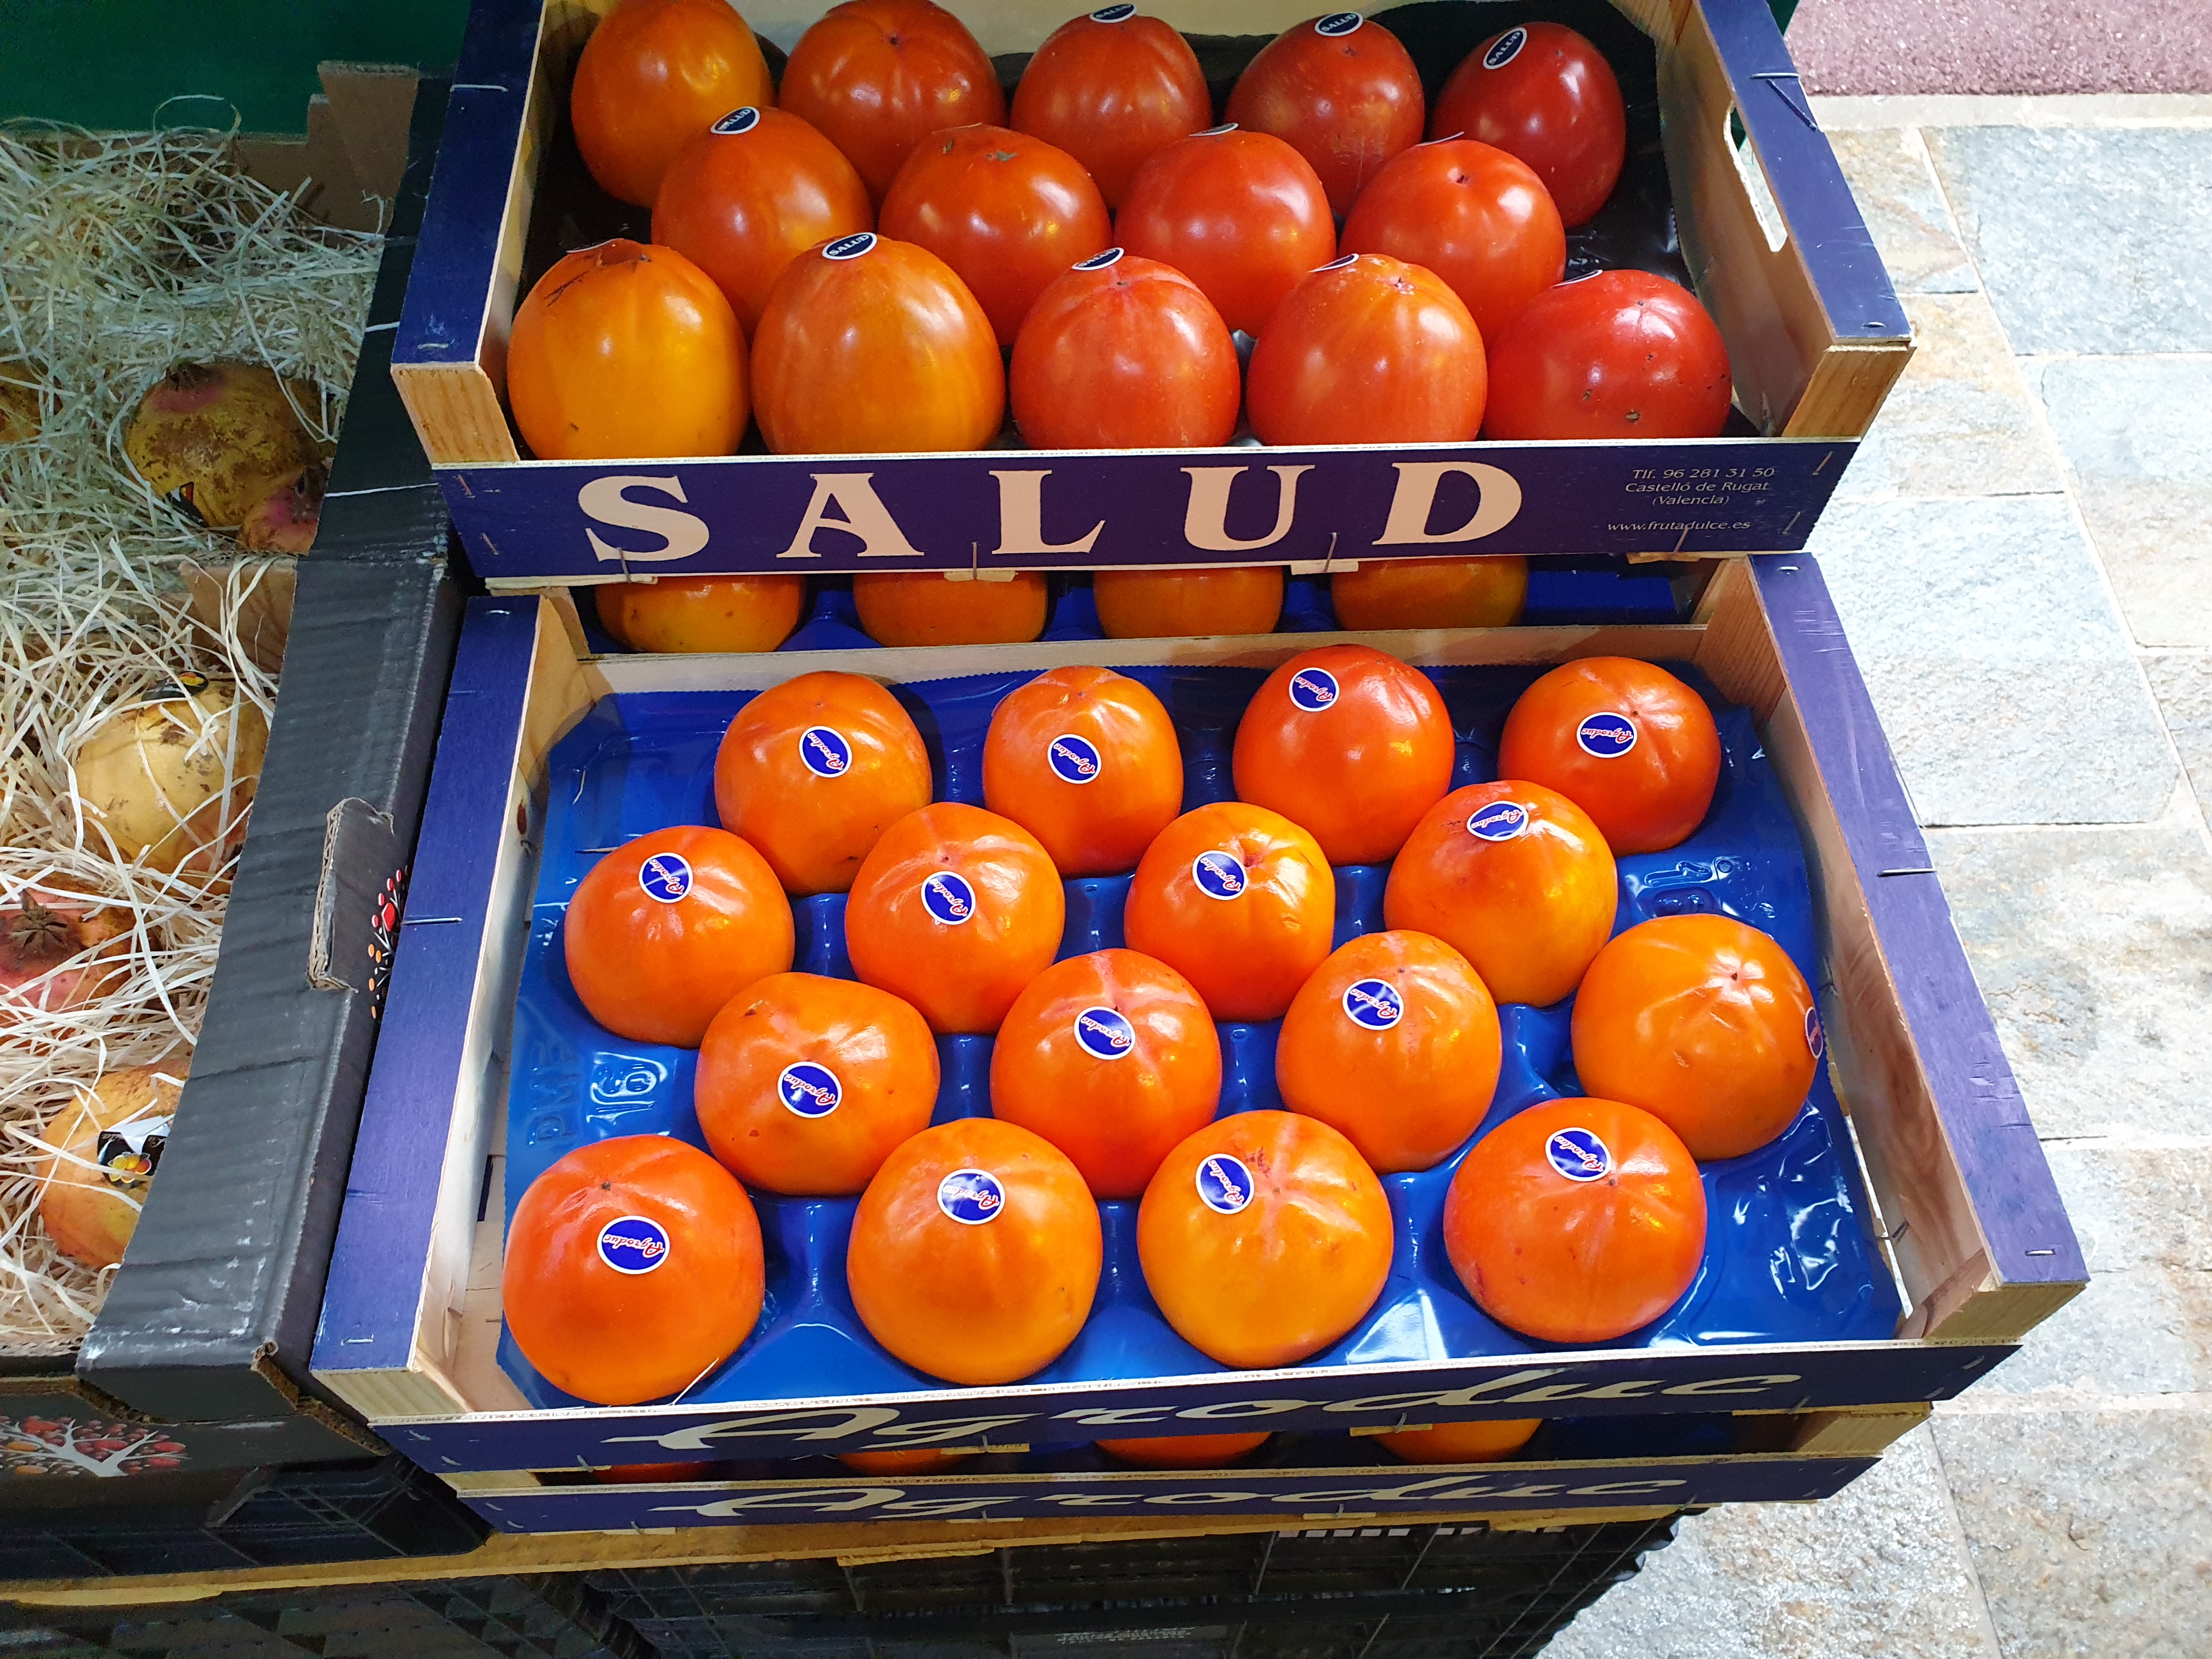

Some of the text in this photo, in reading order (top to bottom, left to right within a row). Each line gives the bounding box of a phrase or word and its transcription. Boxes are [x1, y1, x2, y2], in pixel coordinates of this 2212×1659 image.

[1322, 14, 1356, 32] SALUD
[1488, 32, 1520, 65] SALUD
[718, 109, 751, 131] SALUD
[829, 235, 869, 256] SALUD
[1625, 482, 1770, 493] Castelló de Rugat
[1633, 467, 1775, 479] Tlf. 96 281 31 50
[578, 461, 1522, 561] SALUD
[1652, 495, 1730, 506] (Valencia)
[1607, 521, 1751, 531] www.frutadulce.es
[1295, 676, 1333, 701] Agroduc
[1581, 727, 1633, 743] Agroduc
[807, 732, 844, 770] Agroduc
[1053, 743, 1095, 774] Agroduc
[1471, 809, 1523, 828] Agroduc
[649, 859, 684, 895] Agroduc
[1200, 857, 1242, 891] Agroduc
[930, 878, 968, 917] Agroduc
[1350, 989, 1397, 1019] Agroduc
[1081, 1017, 1131, 1047] Agroduc
[784, 1074, 836, 1106] Agroduc
[1554, 1136, 1604, 1172] Agroduc
[943, 1185, 1000, 1210] Agroduc
[1207, 1160, 1244, 1206] Agroduc
[603, 1234, 664, 1258] Agroduc
[600, 1367, 1801, 1449] Agroduc
[648, 1475, 1687, 1519] Agroduc
